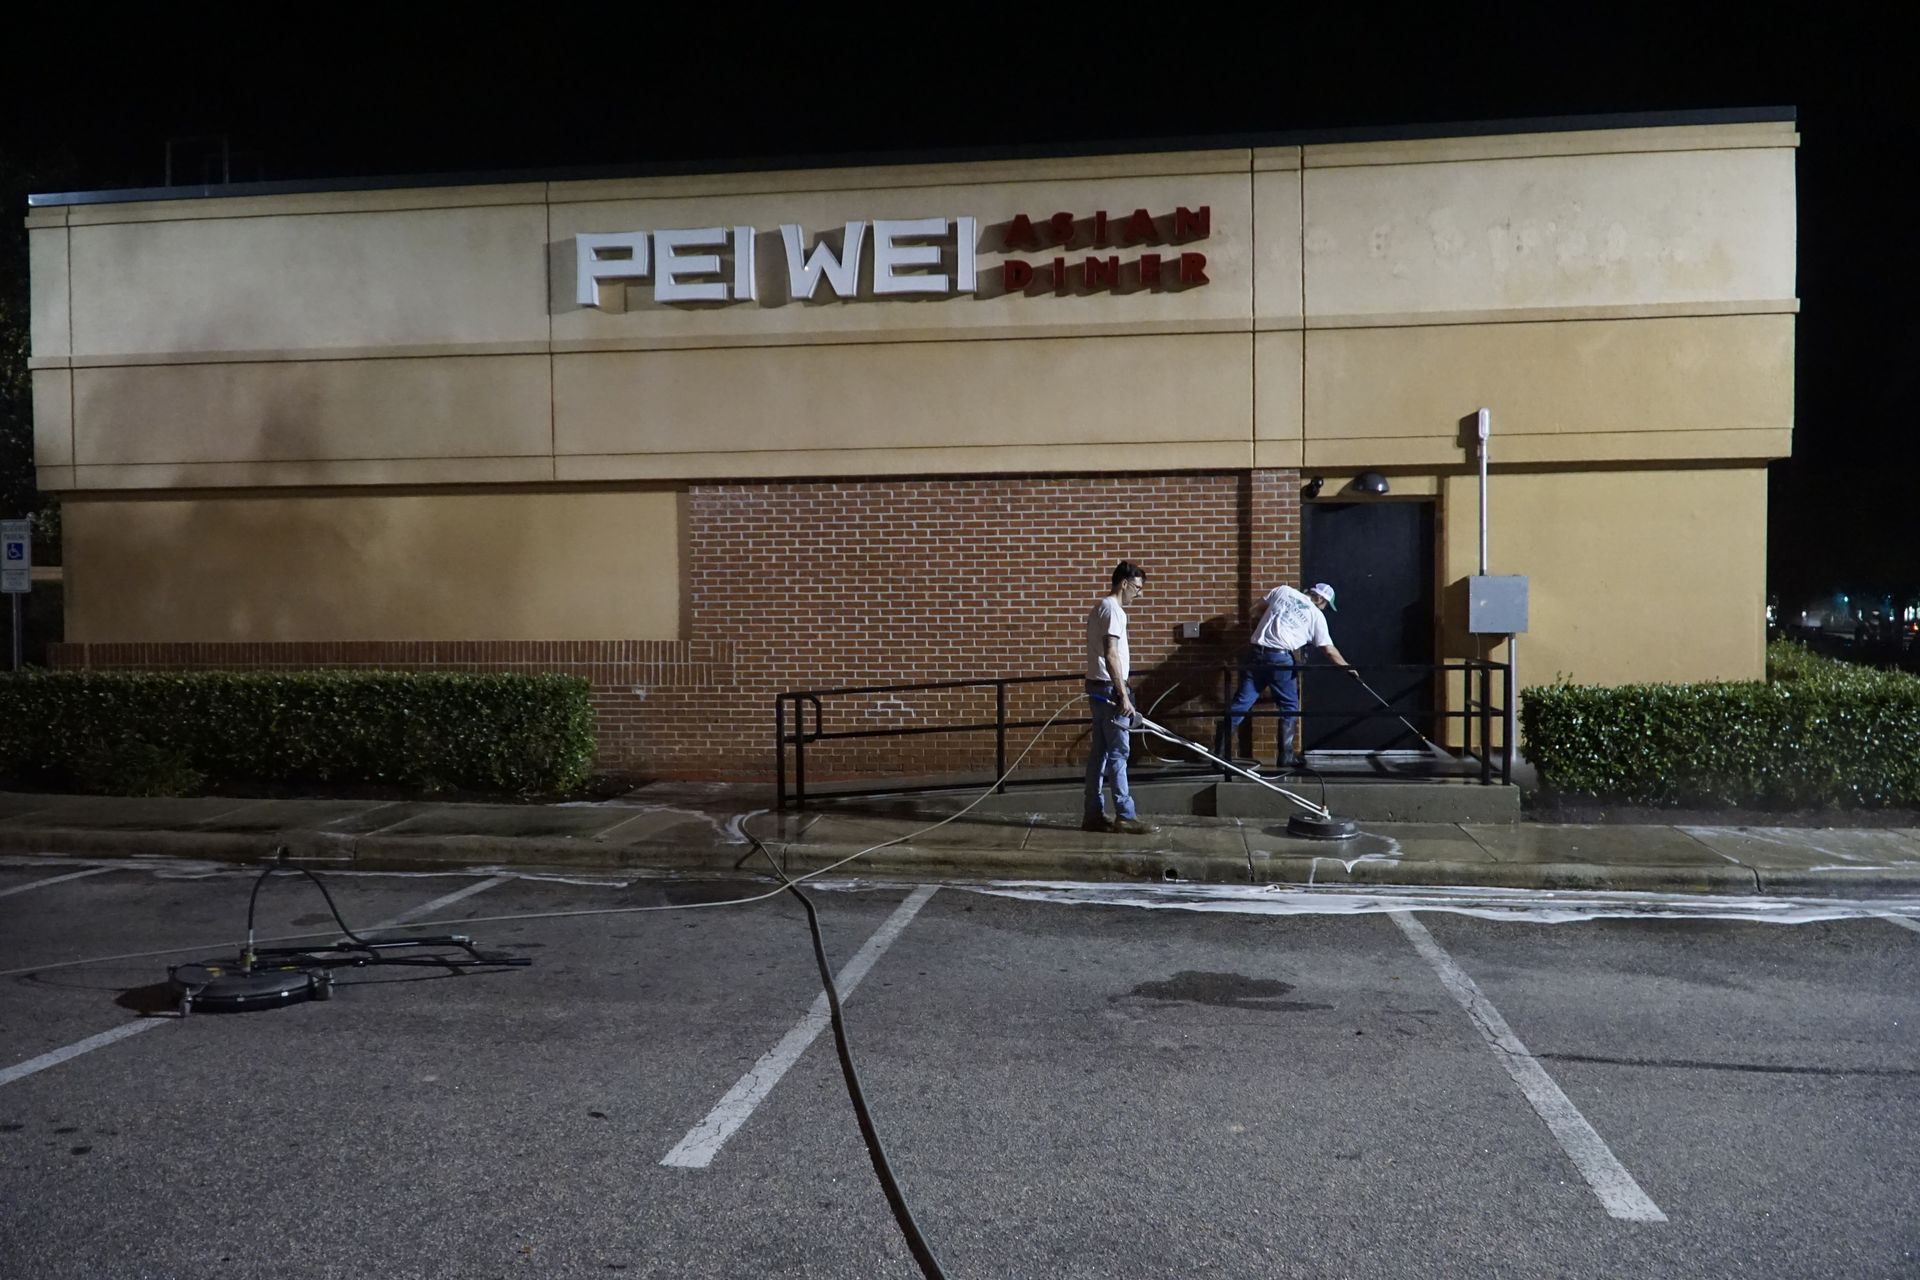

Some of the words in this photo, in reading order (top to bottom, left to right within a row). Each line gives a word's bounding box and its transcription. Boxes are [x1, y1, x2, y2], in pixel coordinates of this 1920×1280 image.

[1003, 206, 1211, 247] ASIAN
[576, 226, 756, 306] PEI
[779, 216, 977, 299] WEI
[1003, 252, 1210, 291] DINER
